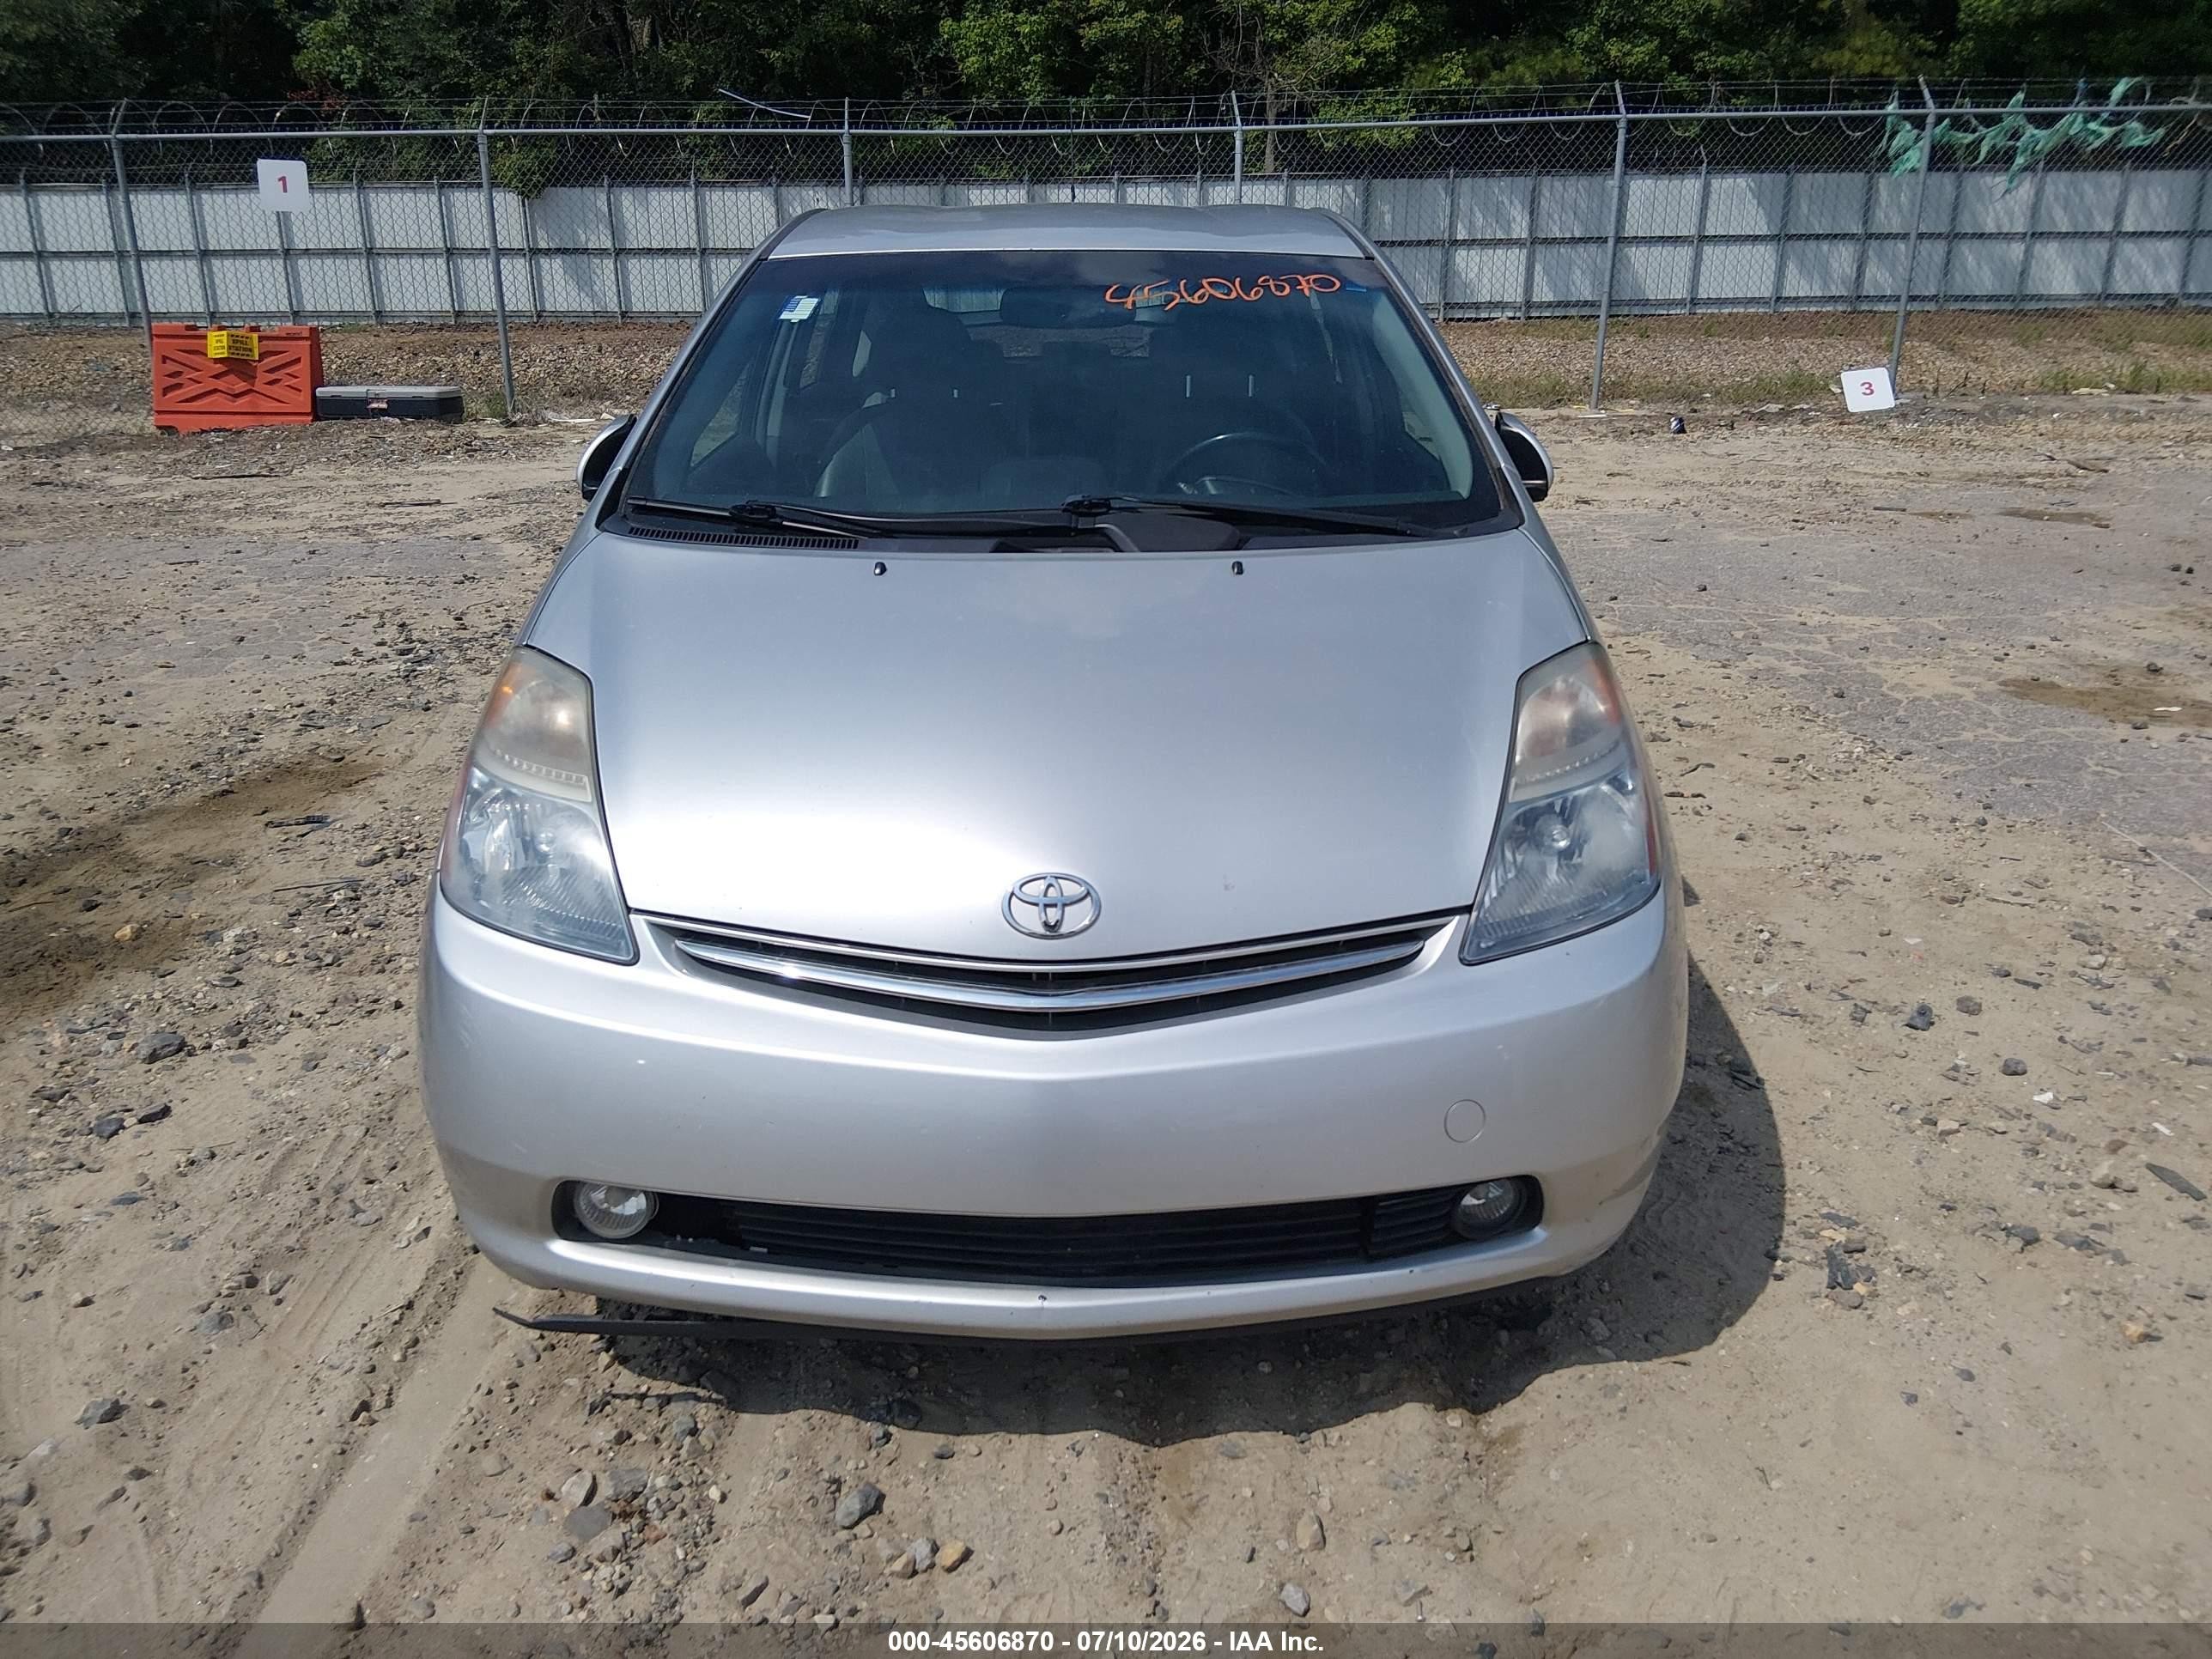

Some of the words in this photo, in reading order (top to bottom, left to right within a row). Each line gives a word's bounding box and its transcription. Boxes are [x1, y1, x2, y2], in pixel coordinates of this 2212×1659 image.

[277, 175, 288, 193] 1
[1105, 273, 1340, 311] 45606870
[1860, 381, 1875, 396] 3
